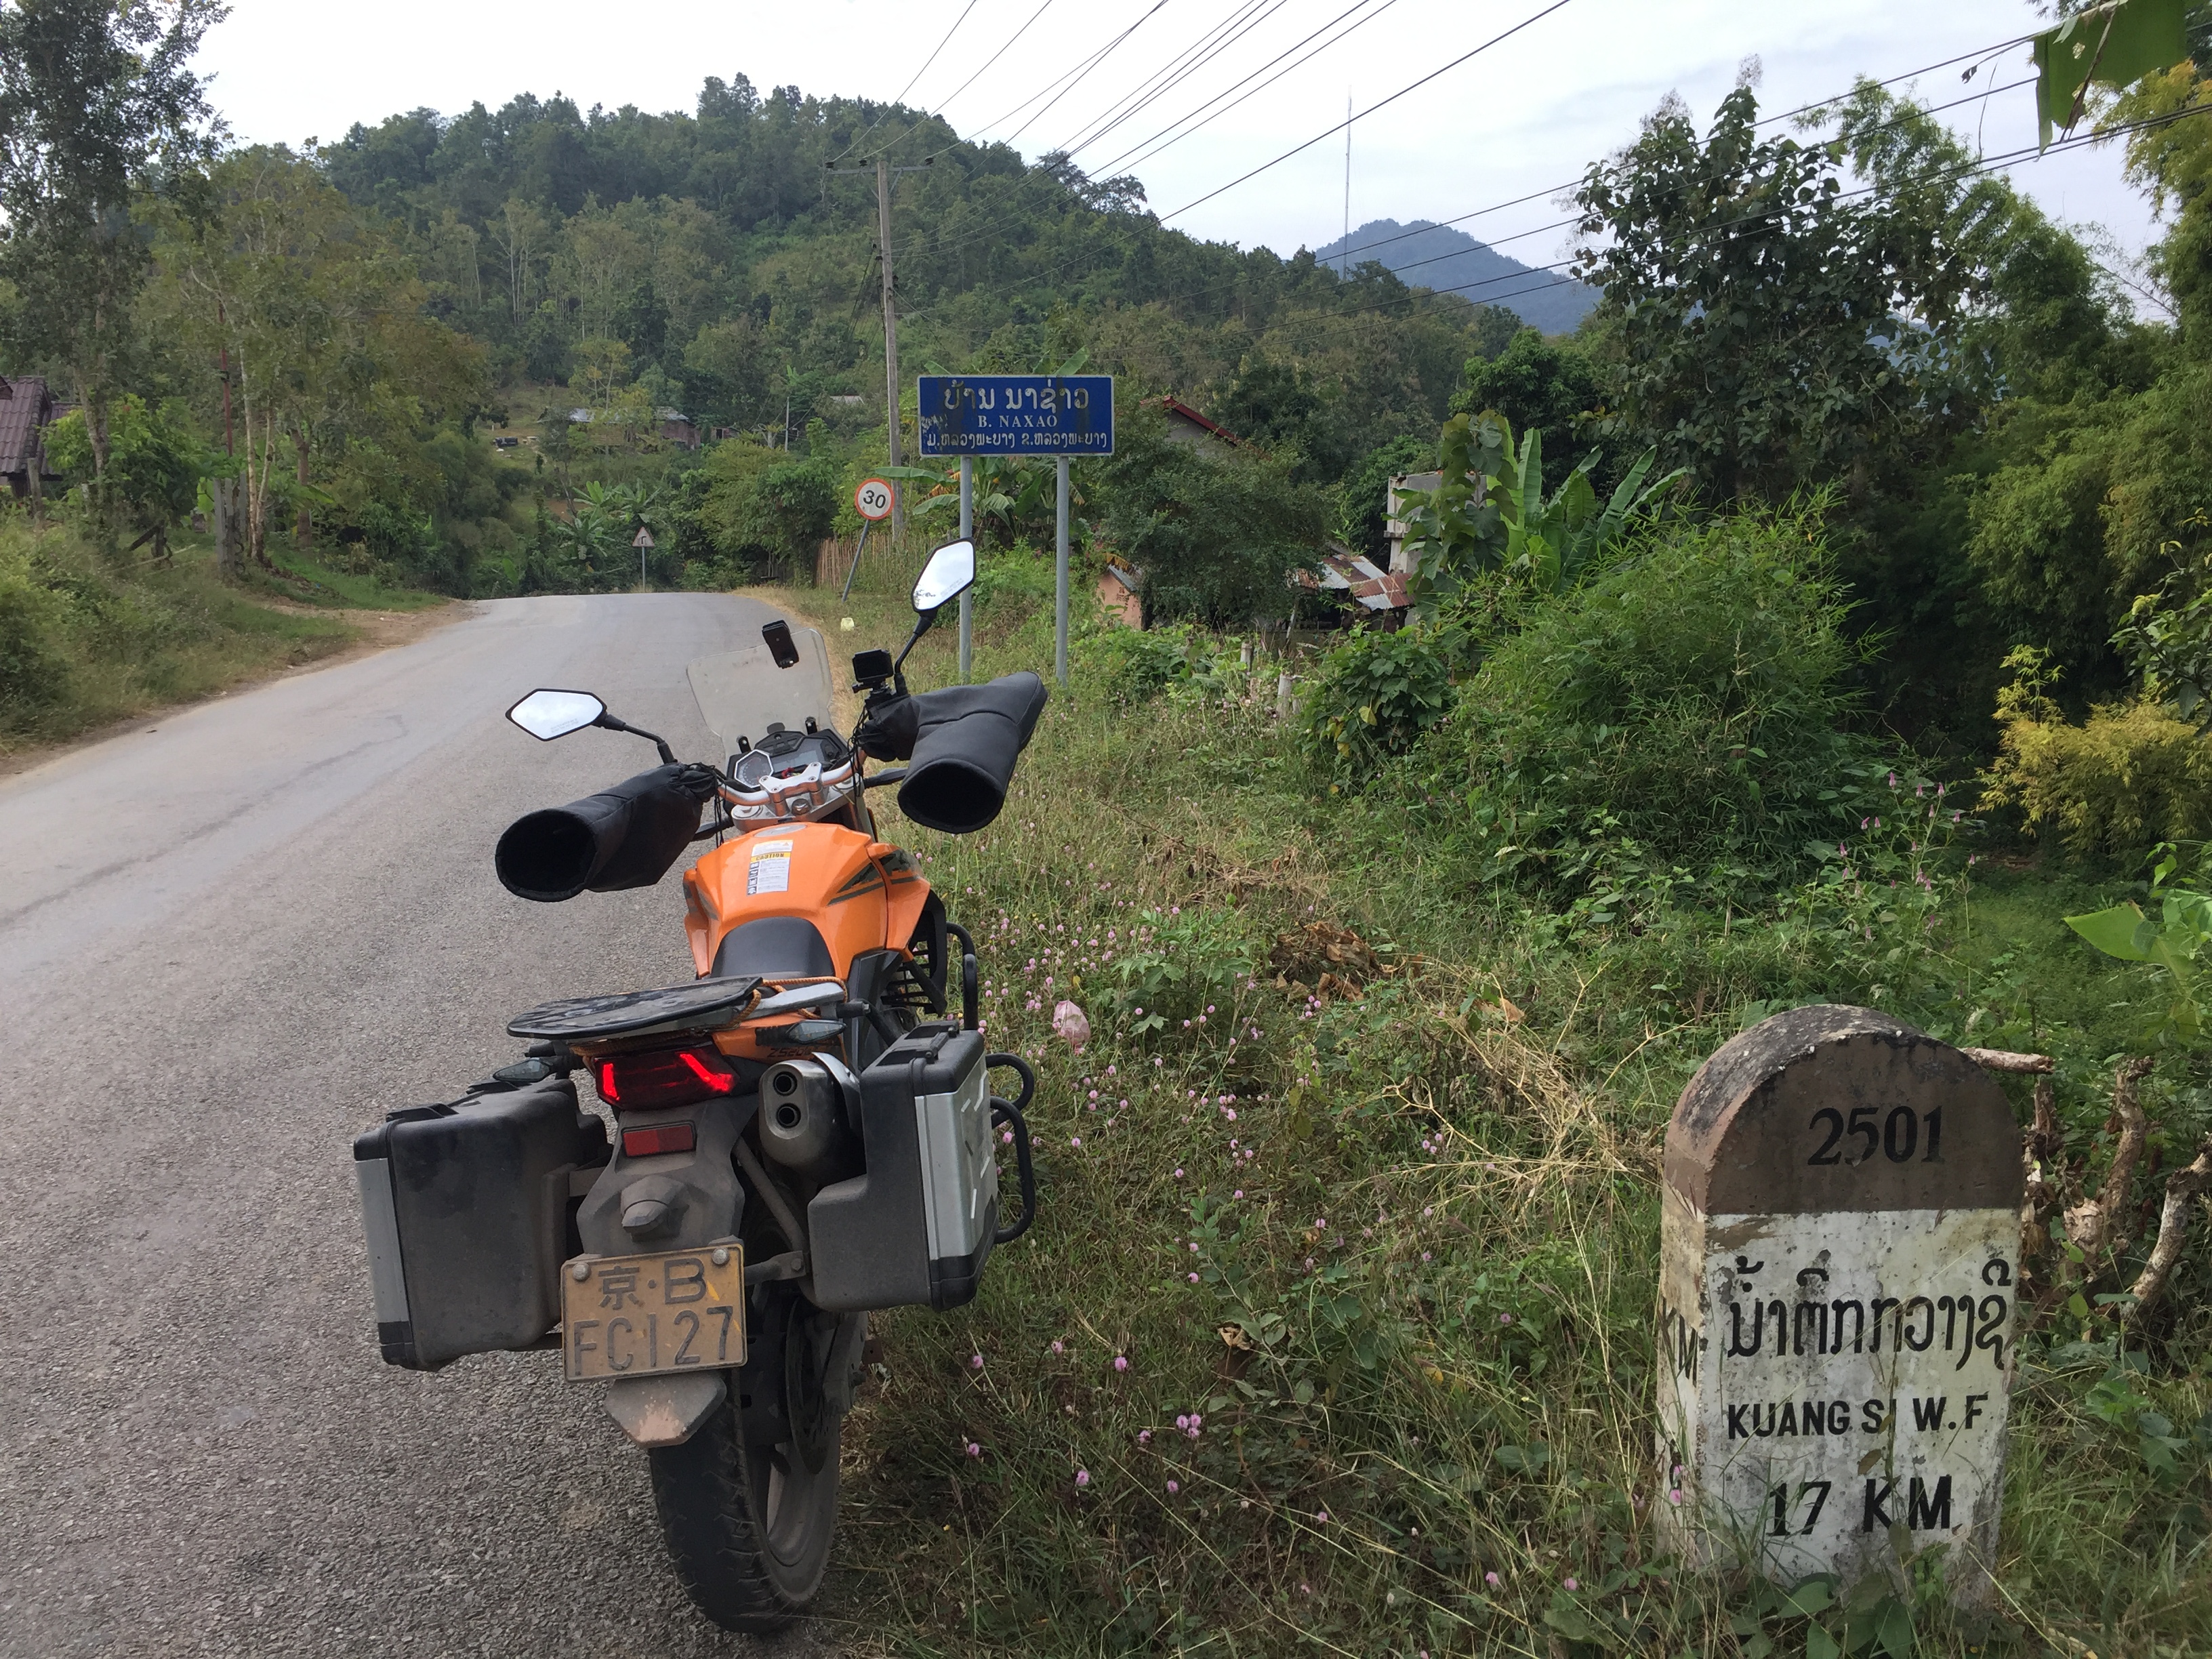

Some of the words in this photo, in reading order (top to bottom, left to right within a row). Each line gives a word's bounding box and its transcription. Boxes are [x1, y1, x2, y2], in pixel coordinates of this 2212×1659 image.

[978, 415, 992, 428] B.
[1000, 415, 1058, 428] NAXAO
[863, 489, 886, 509] 30
[756, 853, 785, 861] CAUTION
[1807, 1105, 1946, 1166] 2501
[573, 1305, 734, 1376] FC127
[1727, 1399, 1851, 1440] KUANG
[1766, 1480, 1832, 1537] 17
[1862, 1474, 1953, 1534] KM
